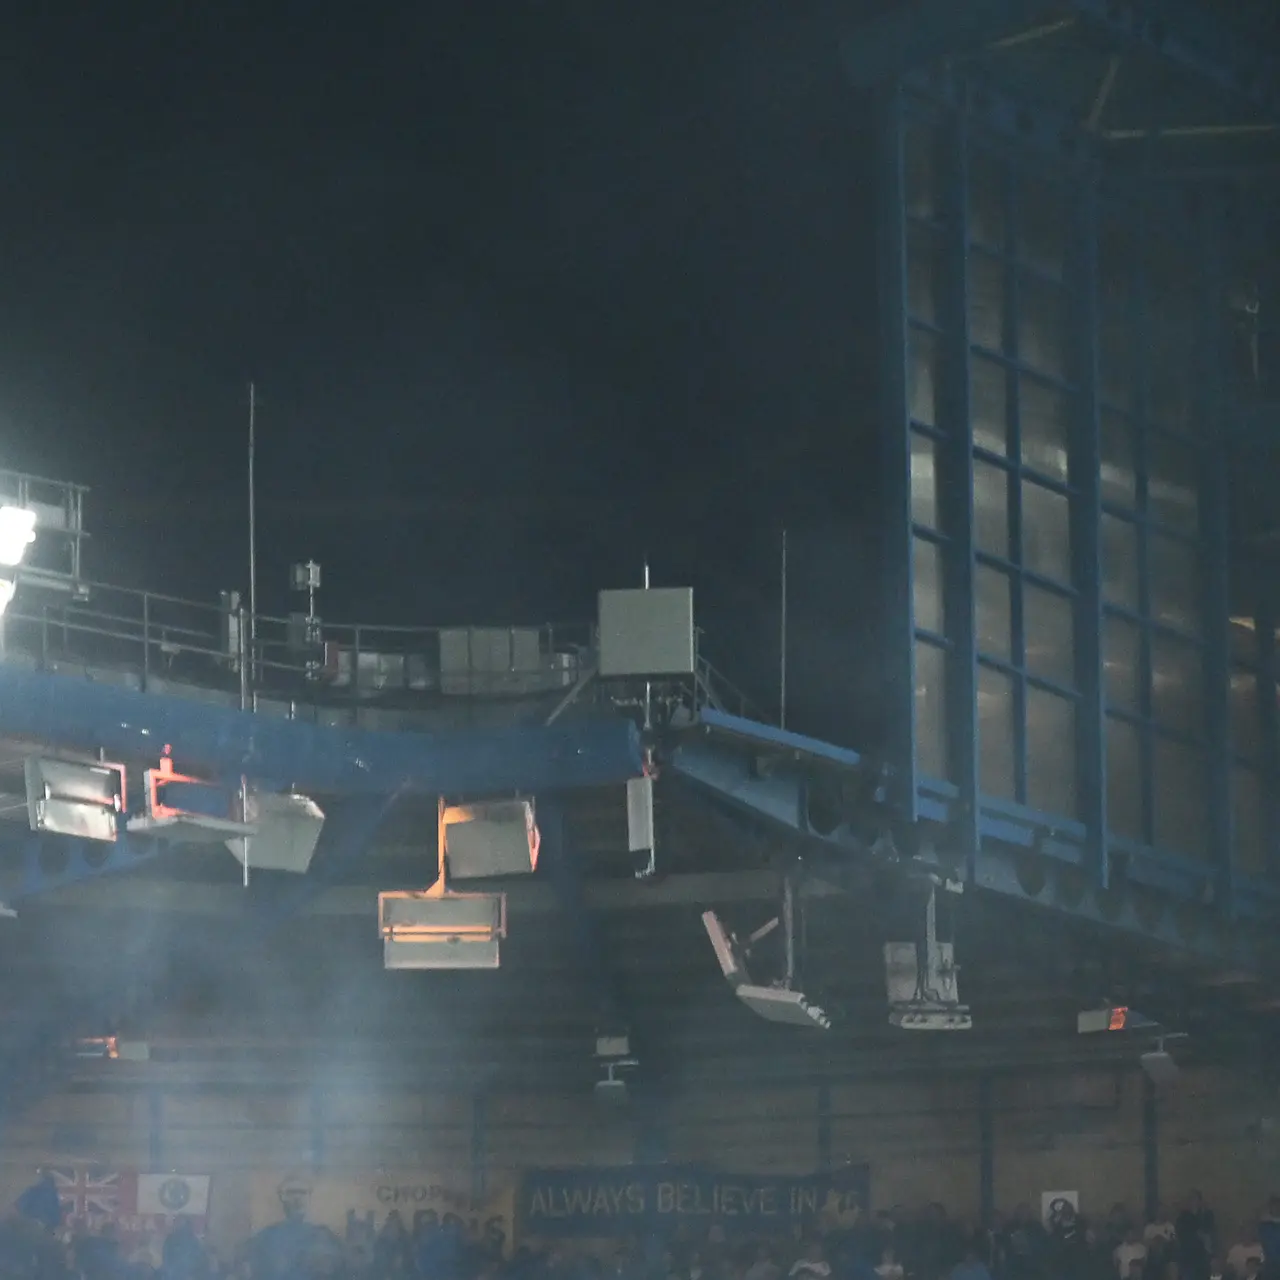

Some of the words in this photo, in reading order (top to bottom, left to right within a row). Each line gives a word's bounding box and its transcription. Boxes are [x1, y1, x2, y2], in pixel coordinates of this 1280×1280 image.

[529, 1183, 645, 1217] ALWAYS
[656, 1180, 778, 1216] BELIEVE
[789, 1184, 818, 1214] IN
